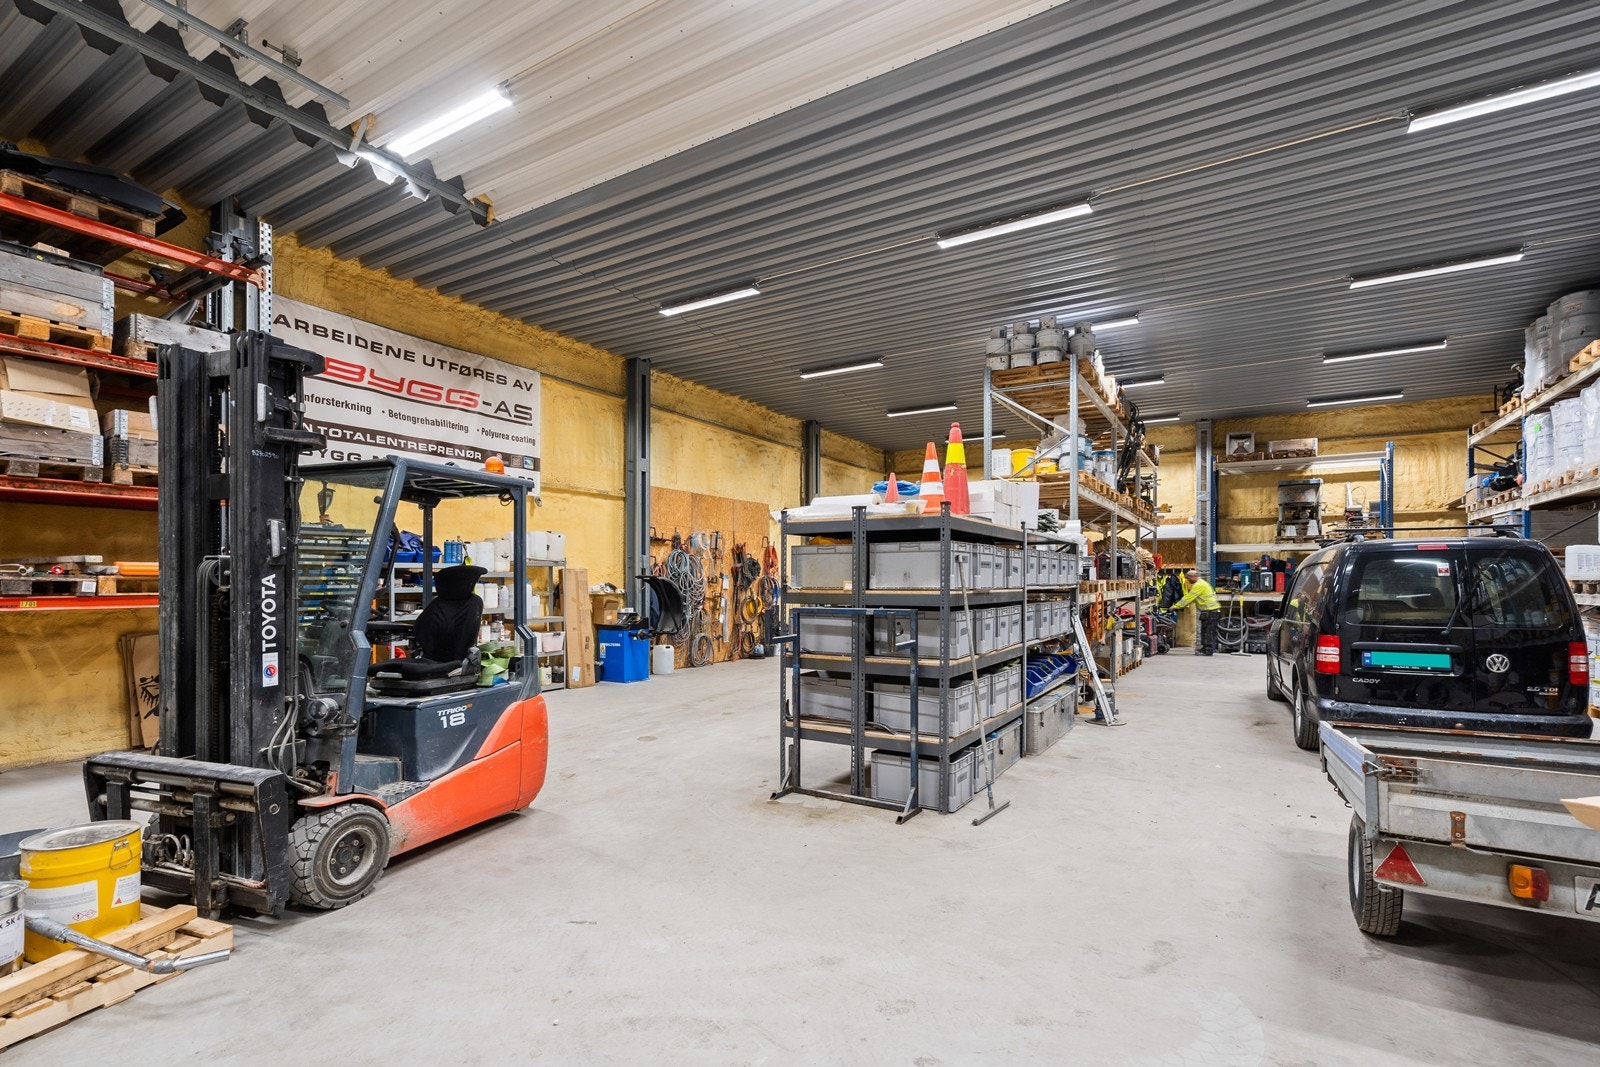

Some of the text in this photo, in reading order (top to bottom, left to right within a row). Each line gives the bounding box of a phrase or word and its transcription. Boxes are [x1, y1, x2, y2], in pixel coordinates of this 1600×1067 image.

[273, 313, 533, 392] ARBEIDENE UTFØRES AV
[303, 393, 536, 446] nforsterkning Betongrehabilitering Polyurea coating
[317, 425, 482, 460] TOTALENTREPRENØR
[261, 574, 277, 653] TOYOTA
[440, 712, 466, 729] 18
